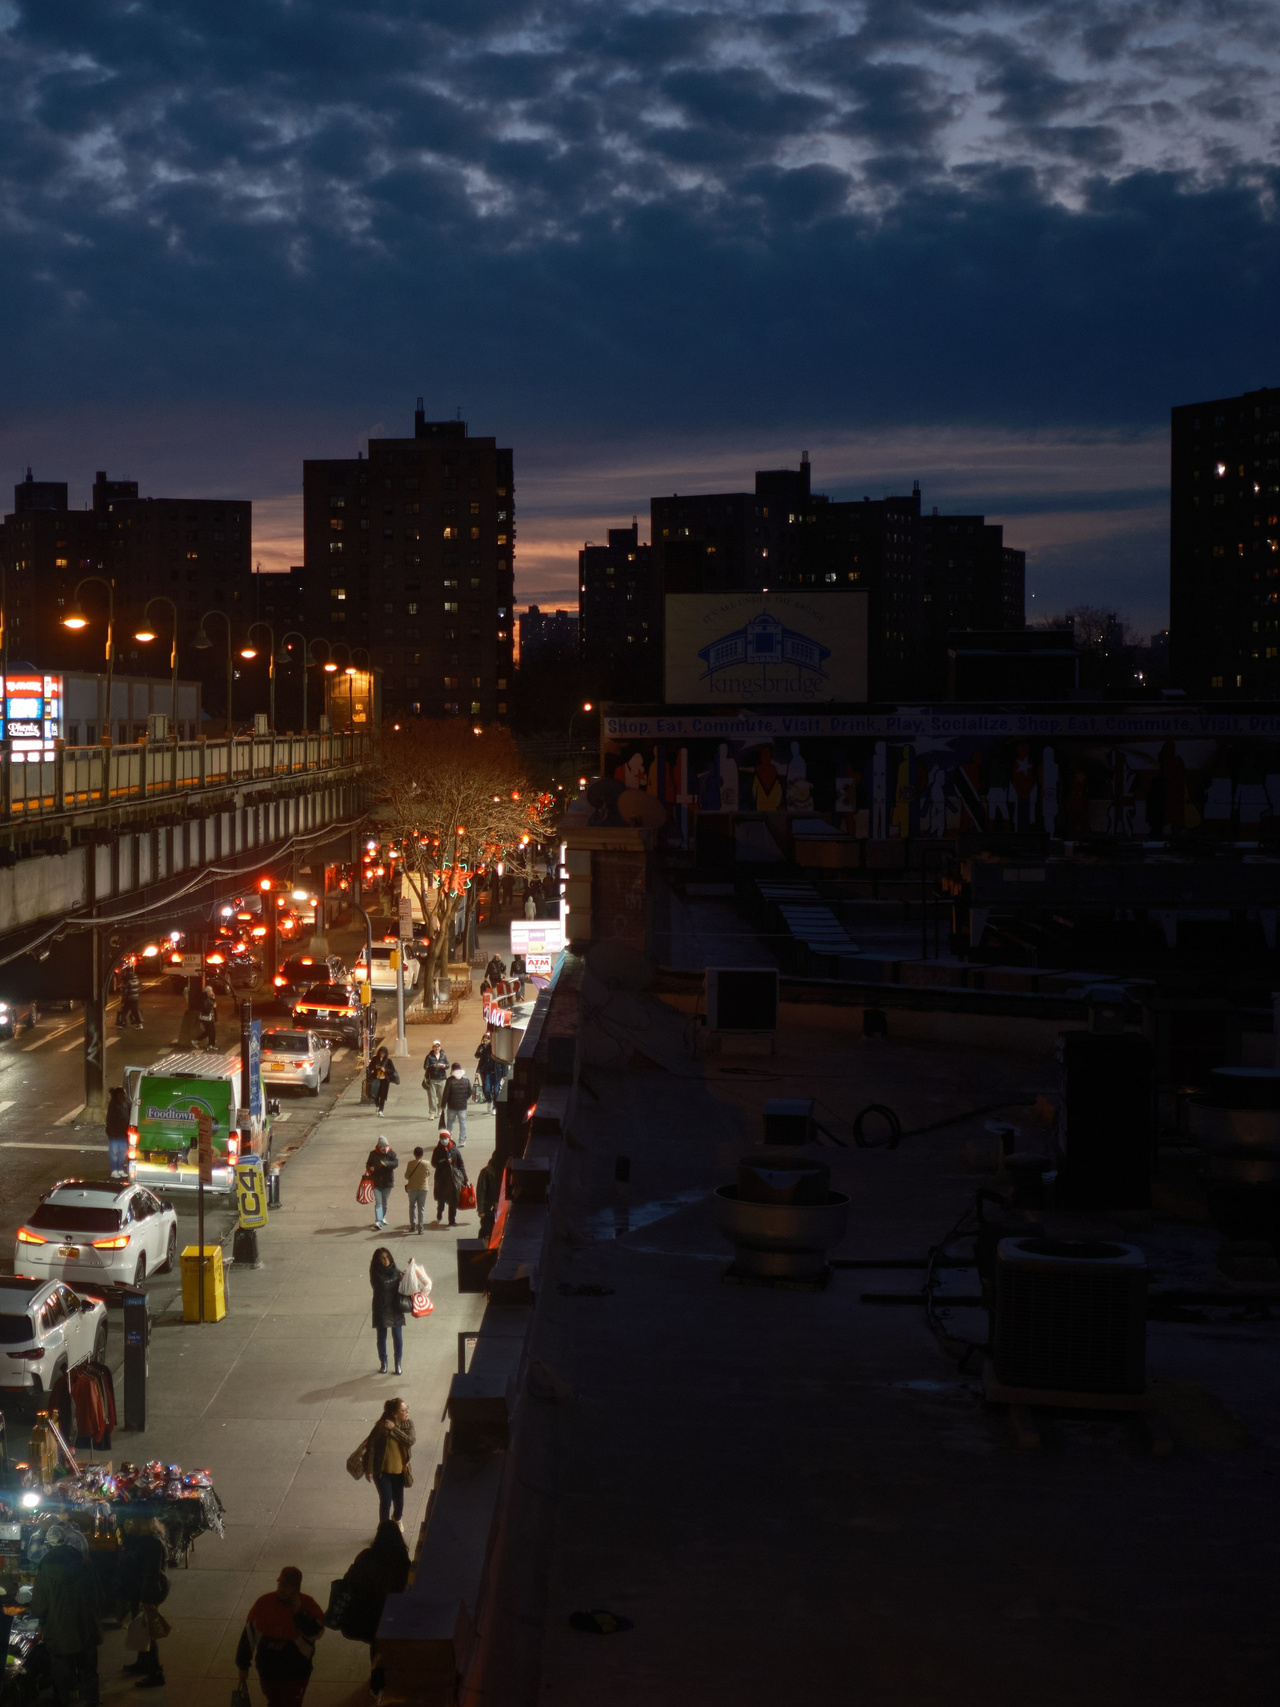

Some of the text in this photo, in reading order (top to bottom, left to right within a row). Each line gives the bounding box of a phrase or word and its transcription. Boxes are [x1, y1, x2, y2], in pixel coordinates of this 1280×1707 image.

[738, 596, 771, 607] UNDER
[775, 596, 793, 606] THE
[794, 600, 826, 623] BRIDGE
[709, 672, 824, 699] kingsbridge
[607, 718, 651, 735] Shop,
[656, 718, 687, 734] Eat,
[692, 717, 777, 733] Commute,
[885, 716, 925, 733] Play,
[931, 716, 1012, 732] Socialize,
[1017, 716, 1063, 734] Shop,
[1105, 716, 1194, 733] Commute,
[147, 1106, 195, 1120] Foodtown
[238, 1168, 261, 1216] C4
